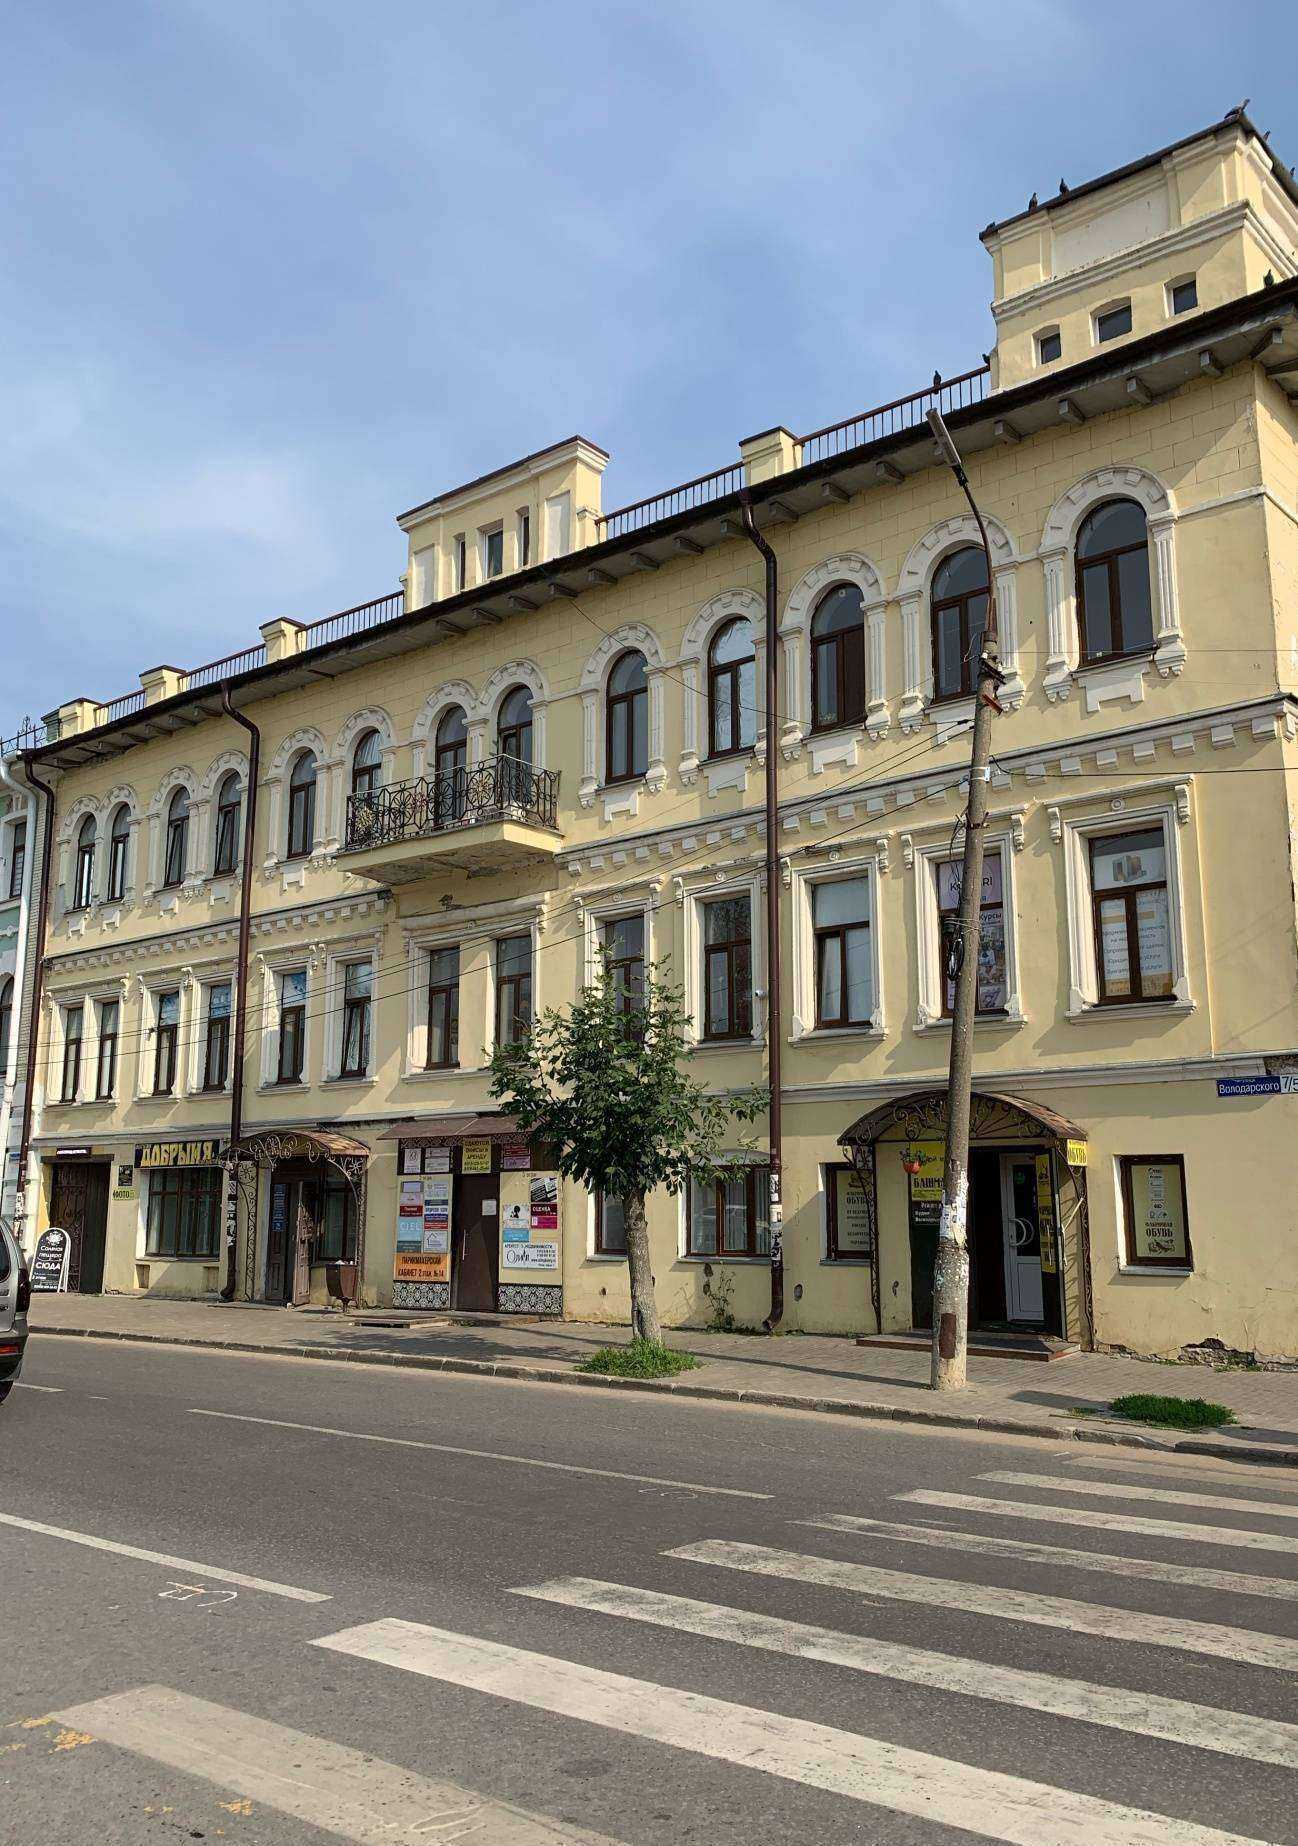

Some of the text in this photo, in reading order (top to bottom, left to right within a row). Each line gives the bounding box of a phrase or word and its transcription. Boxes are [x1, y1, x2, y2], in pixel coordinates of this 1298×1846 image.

[1219, 1082, 1279, 1094] Володарского
[141, 1141, 213, 1167] ДОБРЫНЯ
[1068, 1147, 1087, 1164] ОБУВЬ
[1145, 1227, 1174, 1238] ОБУВЬ
[35, 1262, 61, 1270] СЮДА
